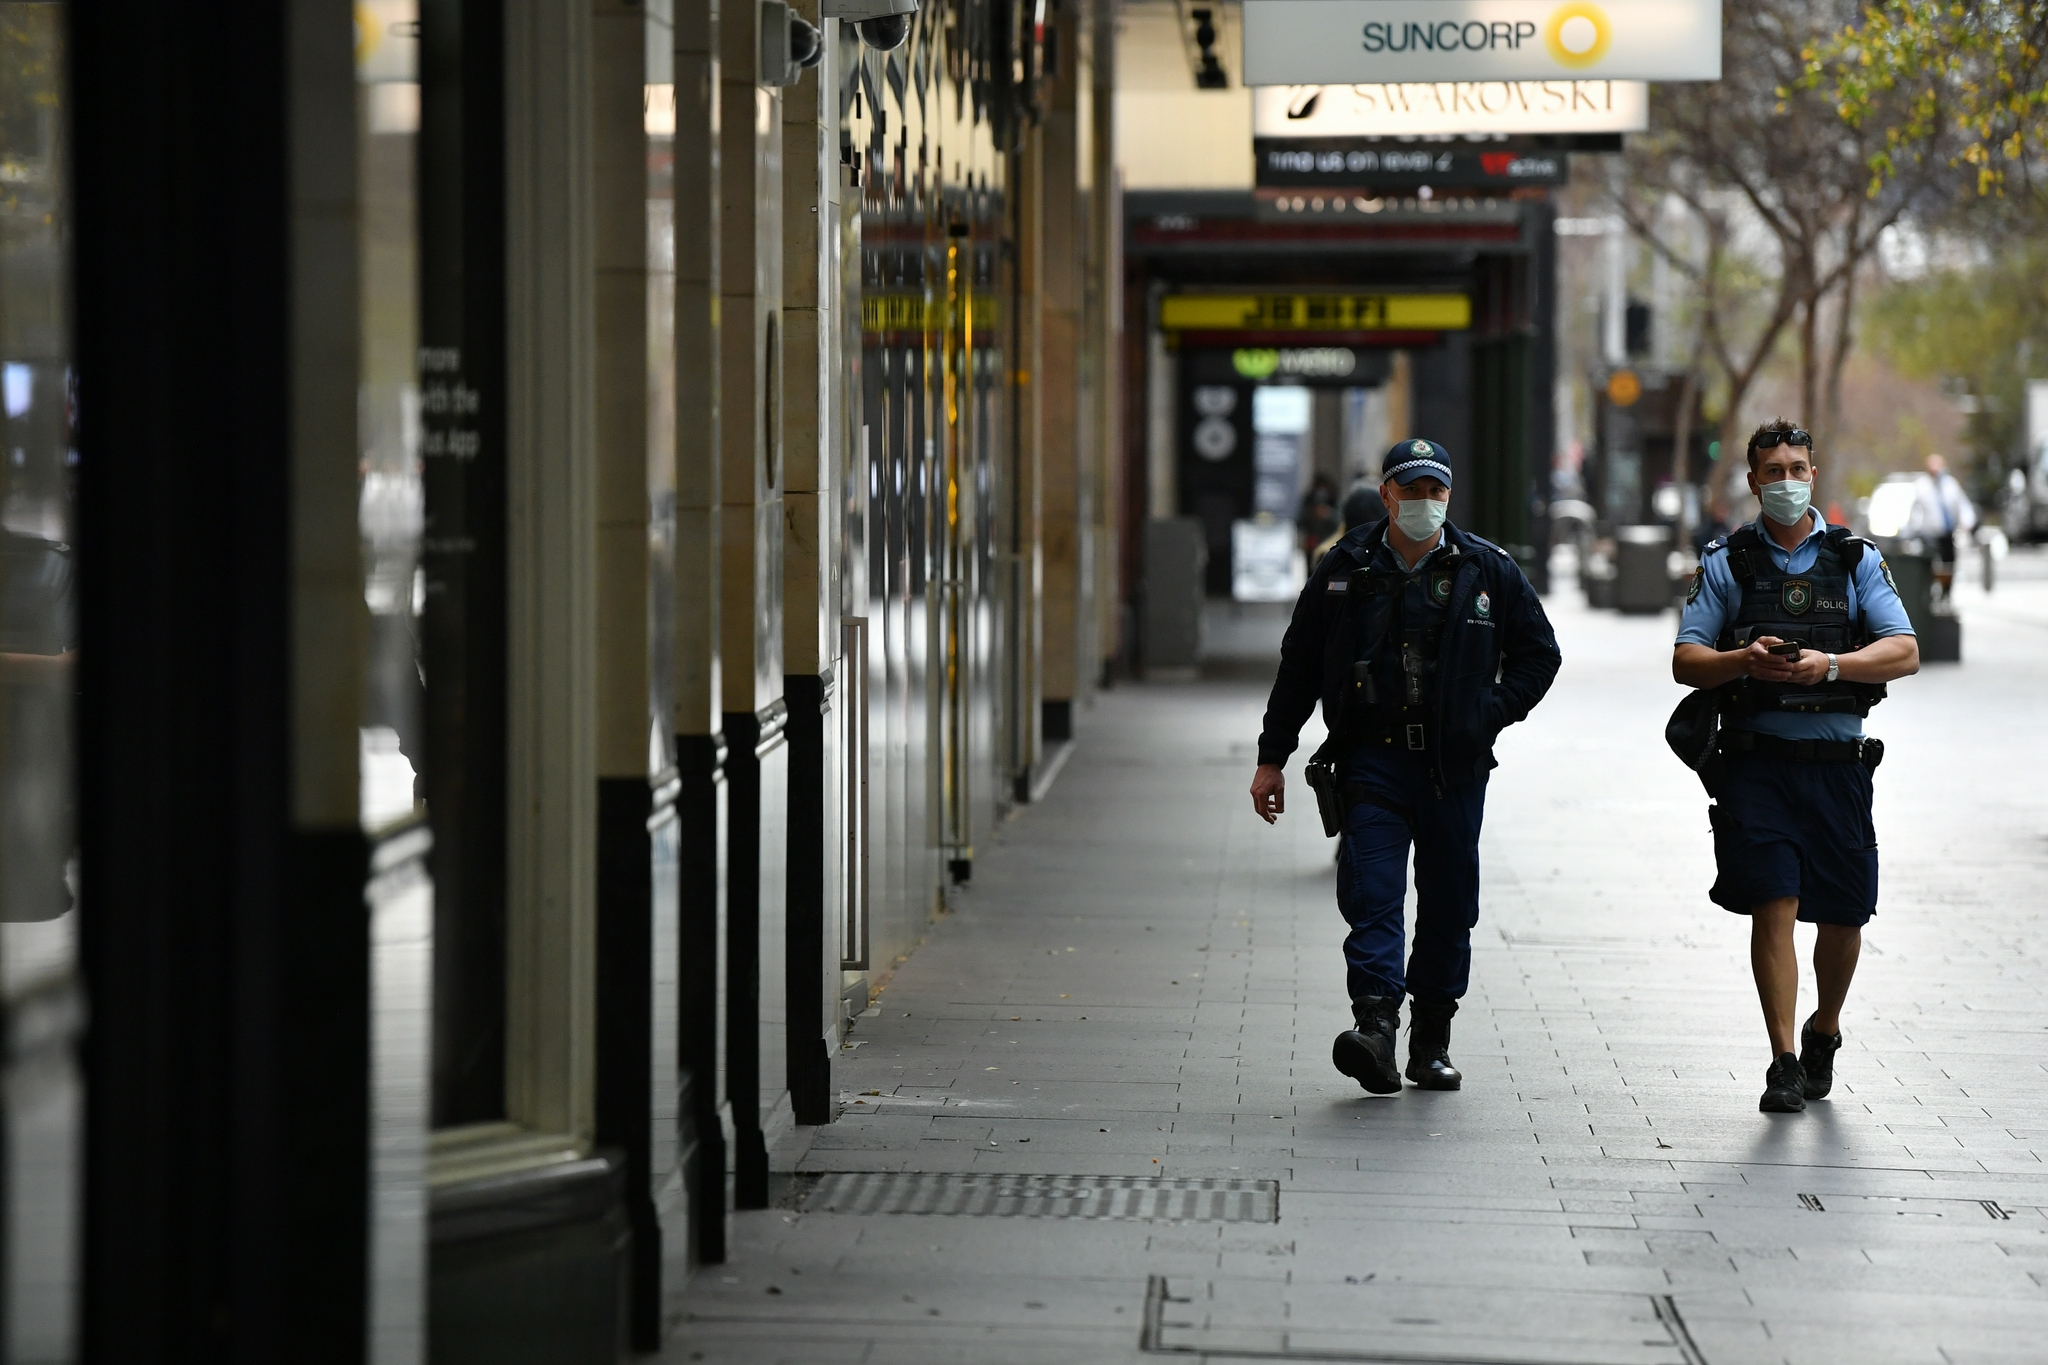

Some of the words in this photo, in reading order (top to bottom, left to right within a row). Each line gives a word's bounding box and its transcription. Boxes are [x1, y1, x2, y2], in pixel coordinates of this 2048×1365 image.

[1363, 21, 1536, 52] SUNCORP
[1353, 82, 1612, 114] SWAROVSKI
[1816, 600, 1848, 610] POLICE
